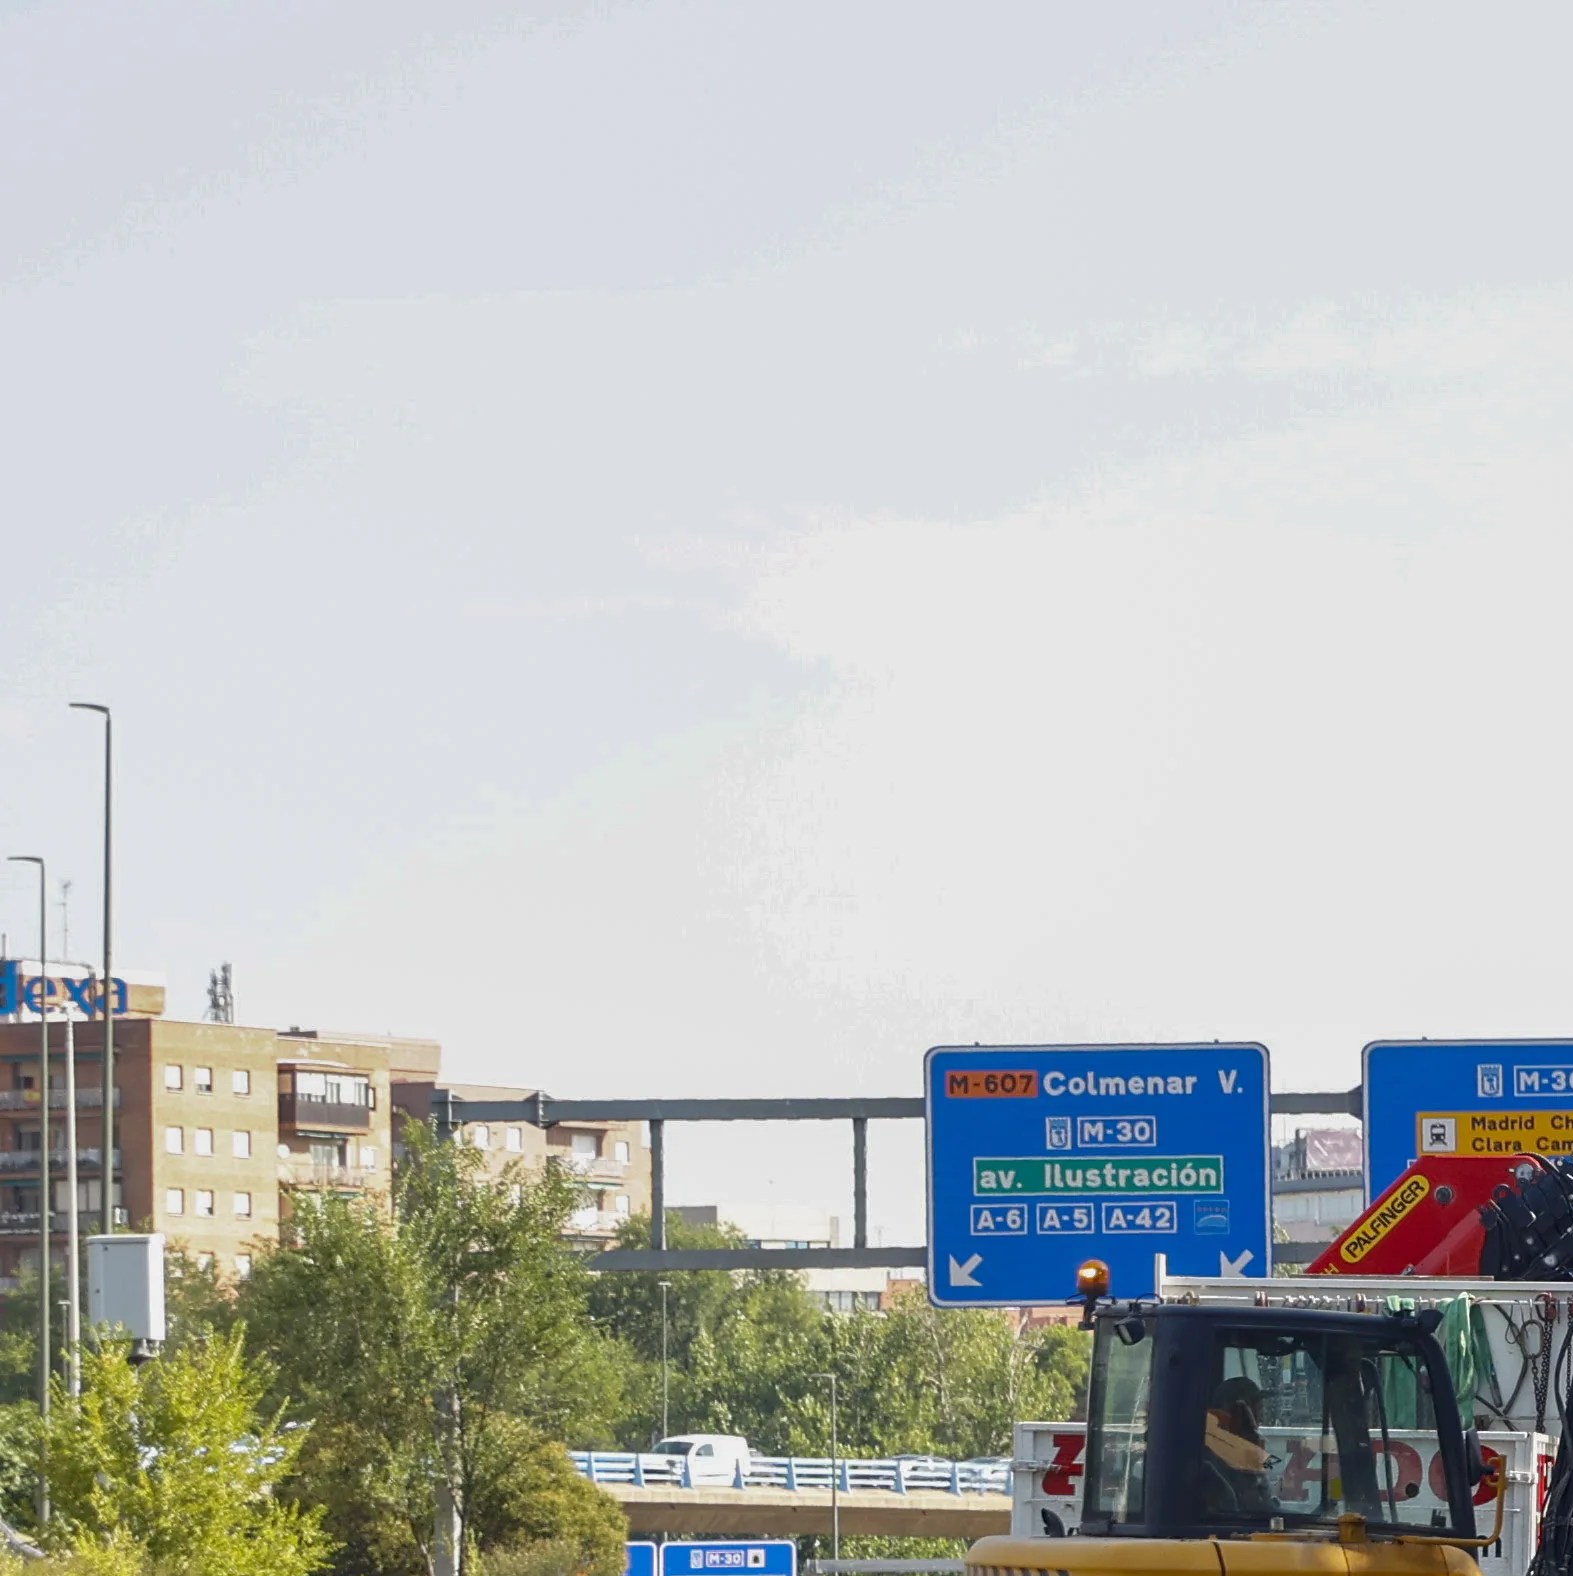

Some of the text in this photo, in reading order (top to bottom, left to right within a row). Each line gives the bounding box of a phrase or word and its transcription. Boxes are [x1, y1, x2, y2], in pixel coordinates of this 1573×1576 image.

[949, 1069, 1244, 1097] M-607 Colmenar V.
[1083, 1121, 1151, 1142] M-30
[1471, 1116, 1535, 1131] Madrid
[1472, 1137, 1522, 1152] Clara
[979, 1163, 1217, 1189] av. Ilustración
[977, 1207, 1171, 1230] A-6 A-5 A-42
[1345, 1180, 1425, 1258] PALFINGER
[710, 1553, 741, 1564] M-30
